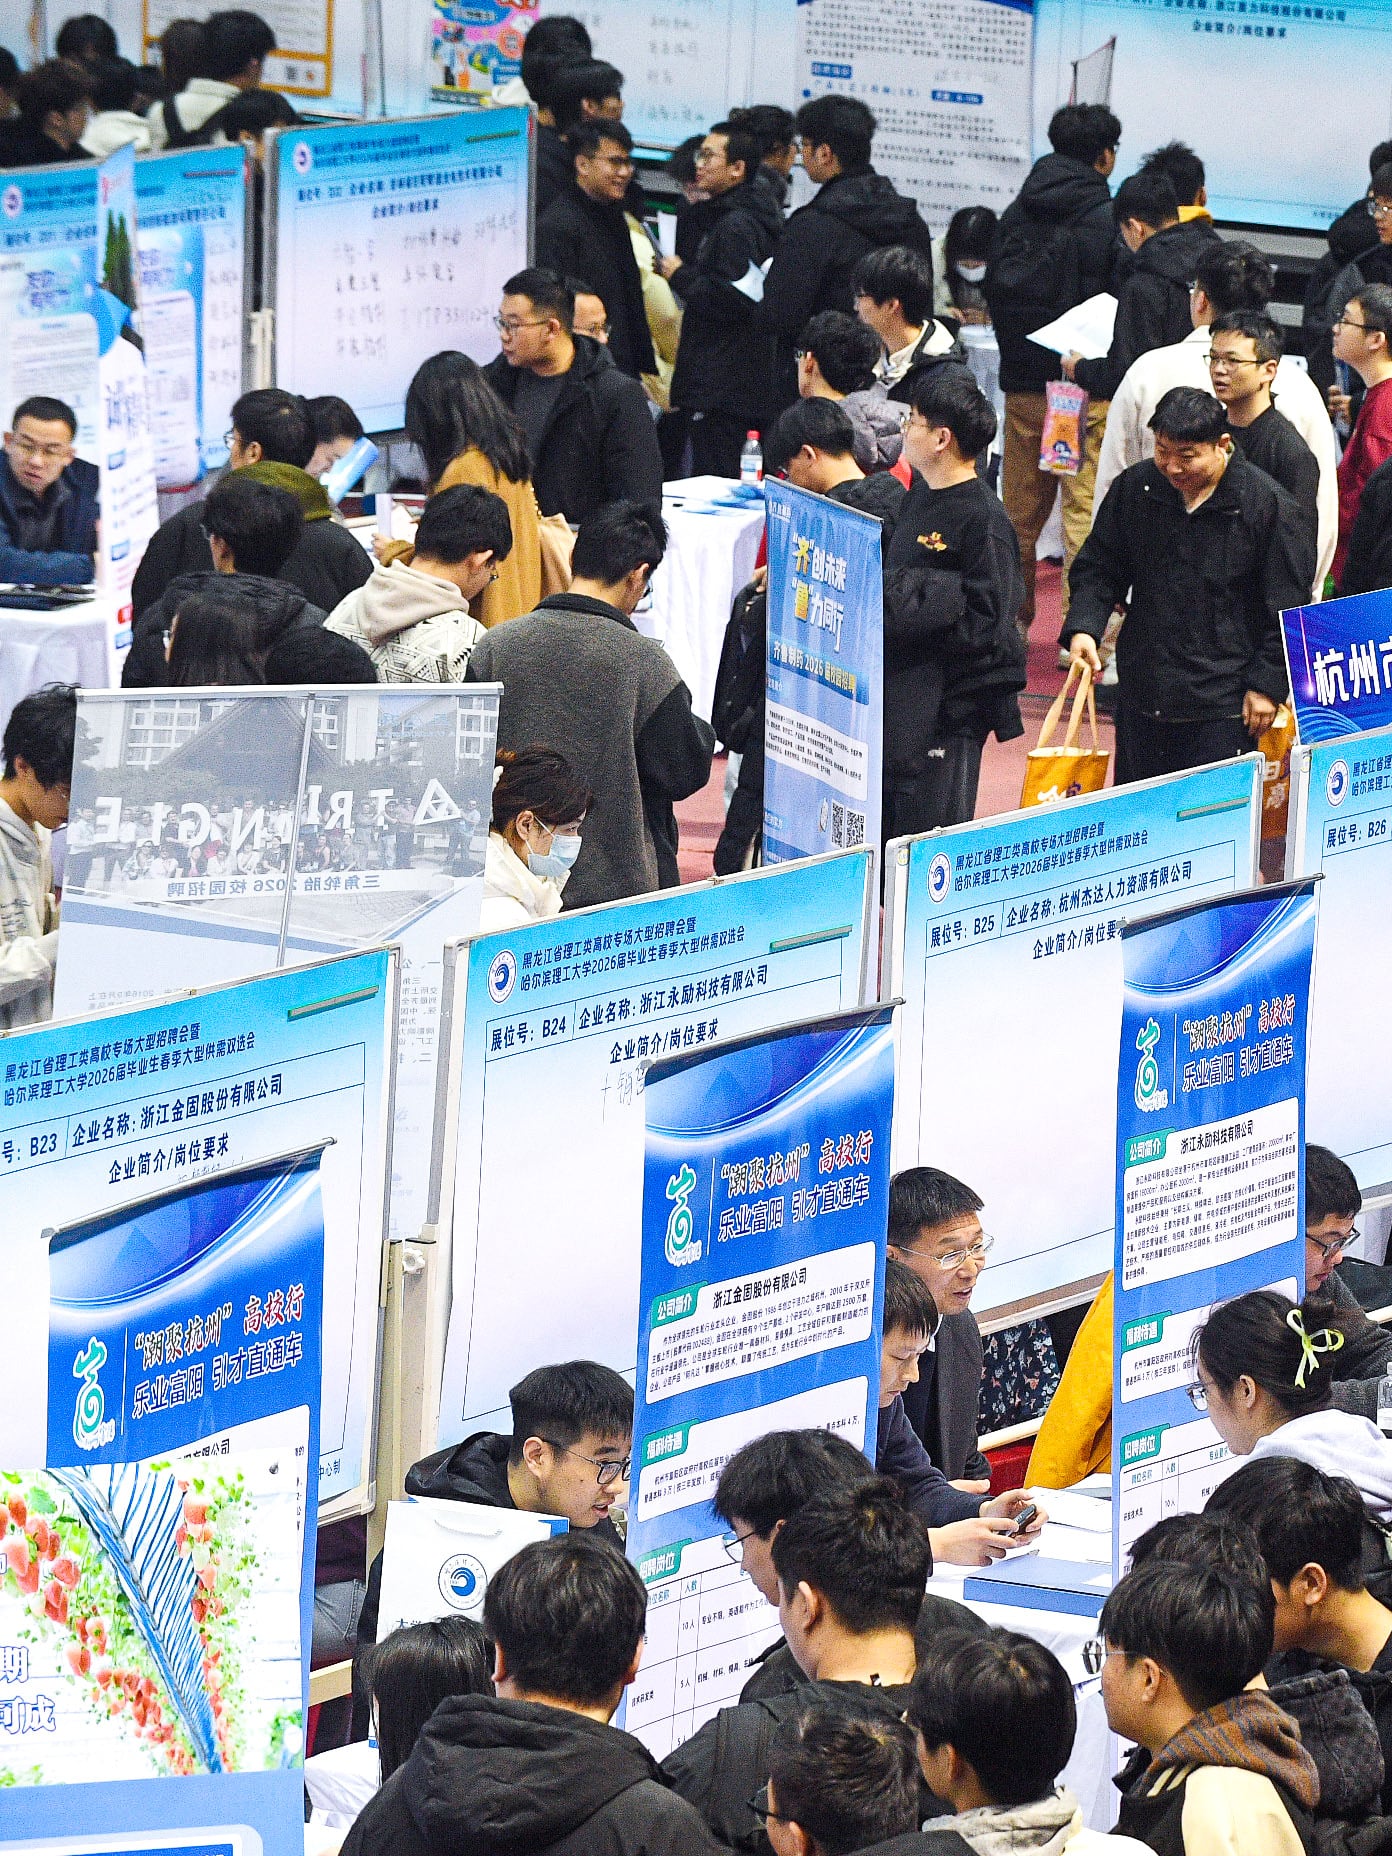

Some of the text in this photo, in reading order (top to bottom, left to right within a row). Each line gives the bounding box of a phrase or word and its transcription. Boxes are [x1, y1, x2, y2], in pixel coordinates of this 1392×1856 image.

[804, 652, 824, 675] 2026
[954, 829, 1149, 893] 哈尔滨理工大学2026届毕业生春季大型供需双选会
[955, 821, 1106, 872] 黑龙江省理工类高校专场大型招聘会暨
[1326, 819, 1388, 850] 展位号：B26
[521, 916, 698, 969] 黑龙江省理工类高校专场大型招聘会暨
[930, 914, 995, 948] 展位号：B25
[1033, 916, 1126, 960] 企业简介/岗位要
[520, 926, 746, 991] 哈尔滨理工大学2026届毕业生春季大型供需双选会
[490, 1016, 567, 1052] 展位号：B24
[609, 1018, 720, 1065] 企业简介/岗位要求
[1182, 993, 1295, 1053] “潮聚杭州” 高校行
[3, 1030, 256, 1107] 哈尔滨理工大学2026届毕业生春季大型供需双选会
[4, 1022, 202, 1083] 黑龙江省理工类高校专场大型招聘会暨
[1181, 1033, 1294, 1093] 乐业富阳 引才直通车
[108, 1132, 230, 1185] 企业简介/岗位要求
[721, 1129, 873, 1198] “潮聚杭州” 高校行
[1129, 1119, 1254, 1162] 公司简介 浙江永励科技有限公司
[718, 1173, 871, 1243] 乐业富阳 引才直通车
[657, 1267, 808, 1321] 公司简介 浙江金固股份有限公司
[134, 1283, 304, 1371] “潮聚杭州” 高校行
[131, 1332, 303, 1419] 乐业富阳 引才直通车
[646, 1432, 683, 1459] 福利待遇
